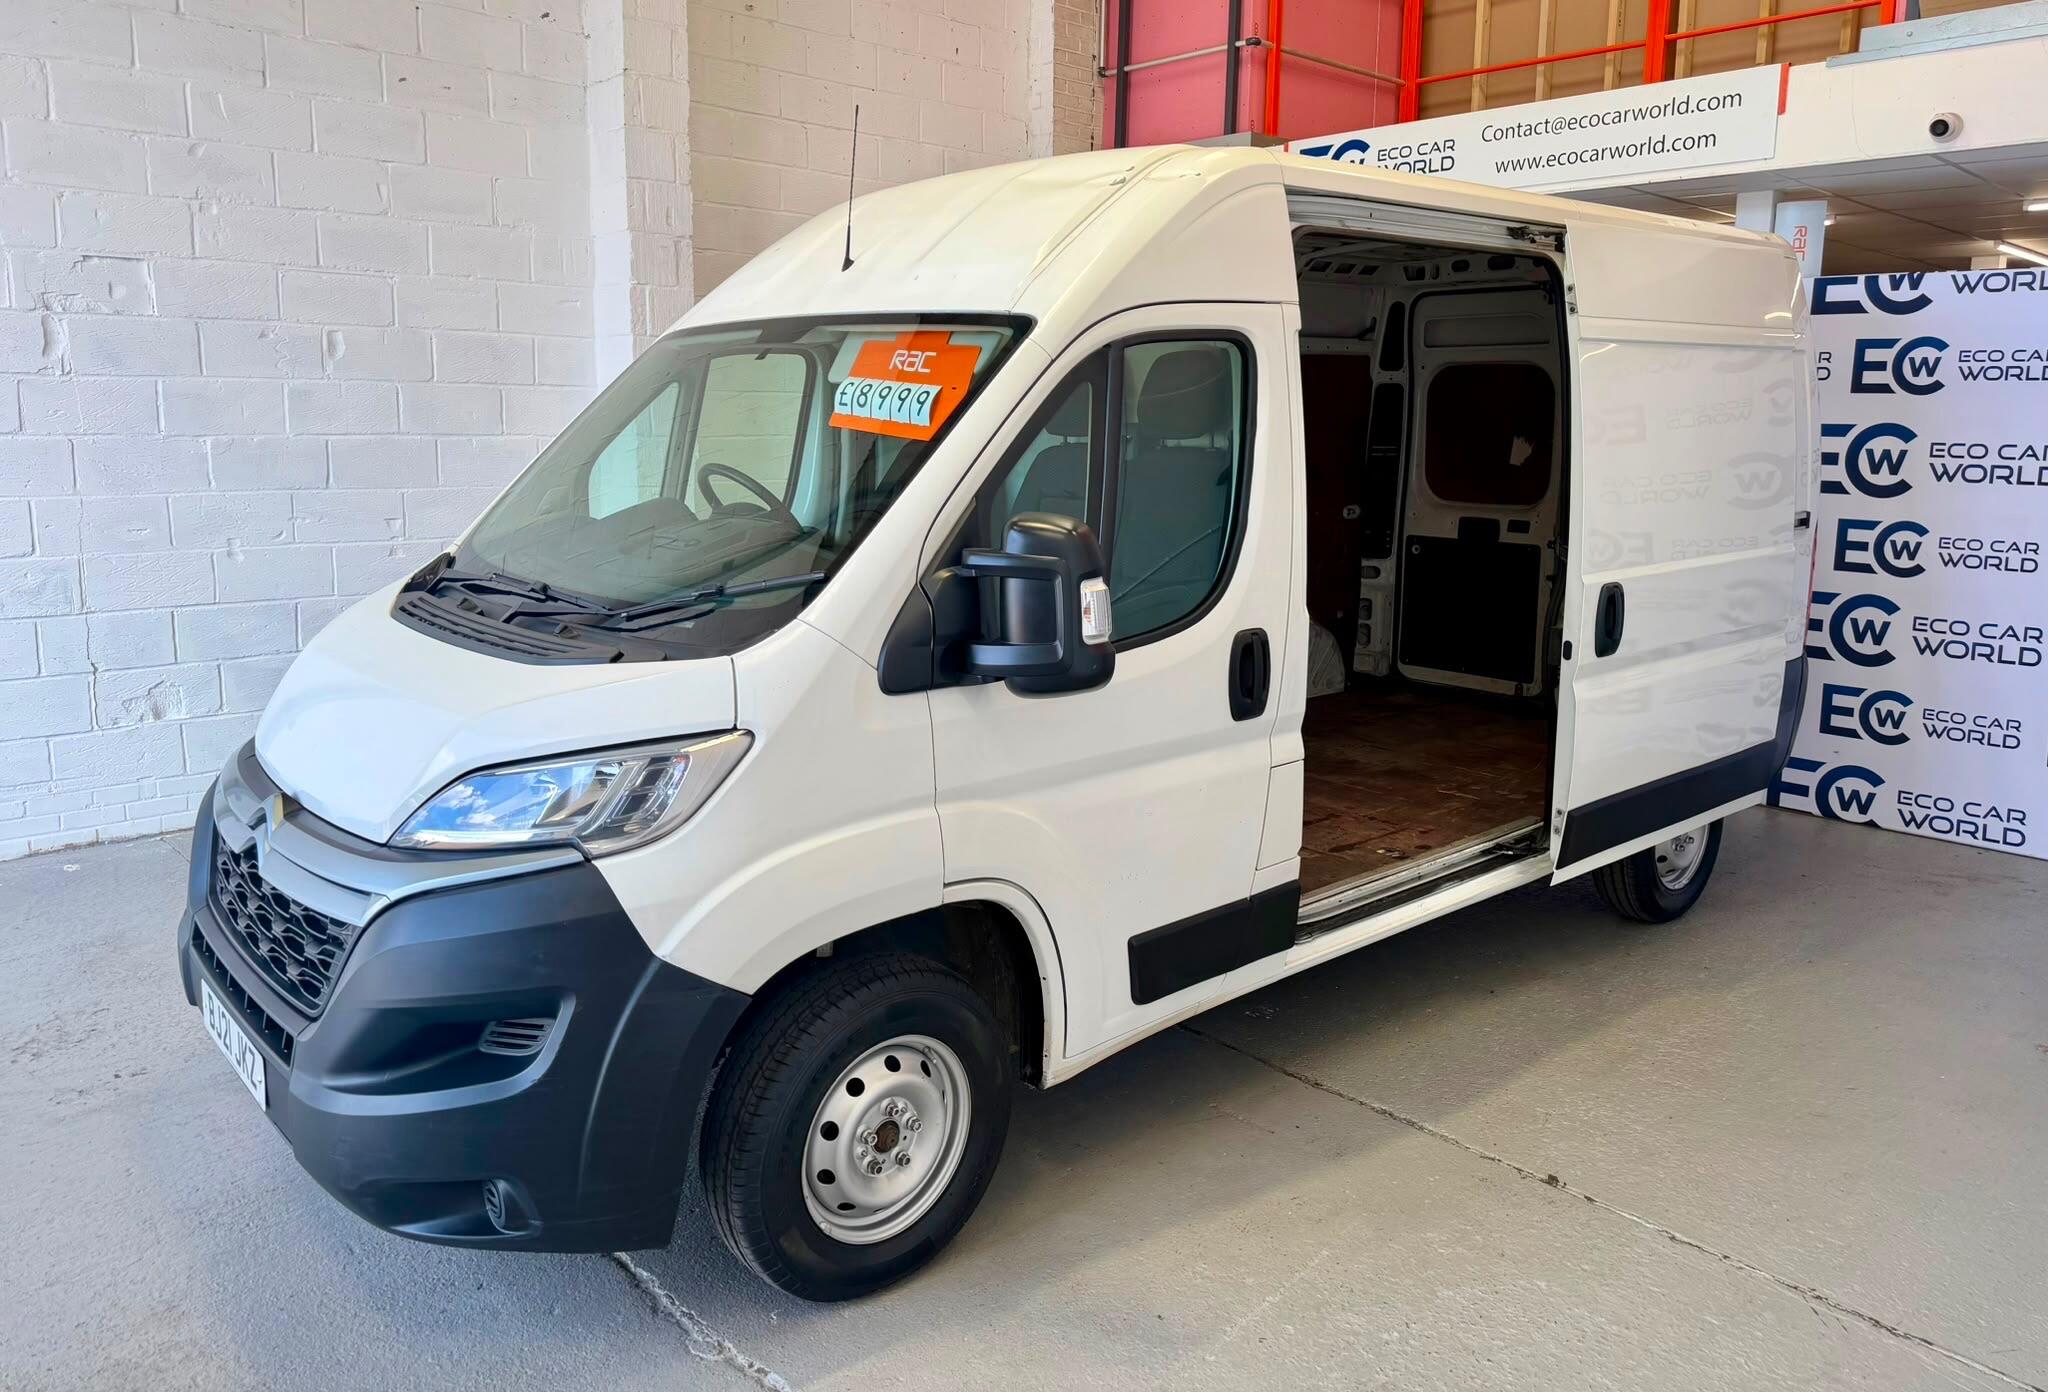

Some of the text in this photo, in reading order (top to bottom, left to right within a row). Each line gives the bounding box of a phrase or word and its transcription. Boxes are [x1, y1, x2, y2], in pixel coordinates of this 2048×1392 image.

[1481, 92, 1742, 142] Contact@ecocarworld.com
[1377, 145, 1412, 162] ECO
[1417, 139, 1456, 156] CAR
[1495, 132, 1717, 174] www.ecocarworld.com
[1958, 349, 2048, 363] ECO CA
[838, 382, 931, 417] £8999
[1929, 442, 2048, 462] ECO CA
[1938, 536, 2040, 556] ECO CAR
[1938, 551, 2039, 574] WORLD
[1912, 616, 2044, 645] ECO CAR
[1912, 635, 2043, 668] WORLD
[1922, 708, 2022, 733] ECO CAR
[1922, 722, 2021, 750] WORLD
[1896, 790, 2027, 827] ECO CAR
[1896, 808, 2027, 847] WORLD
